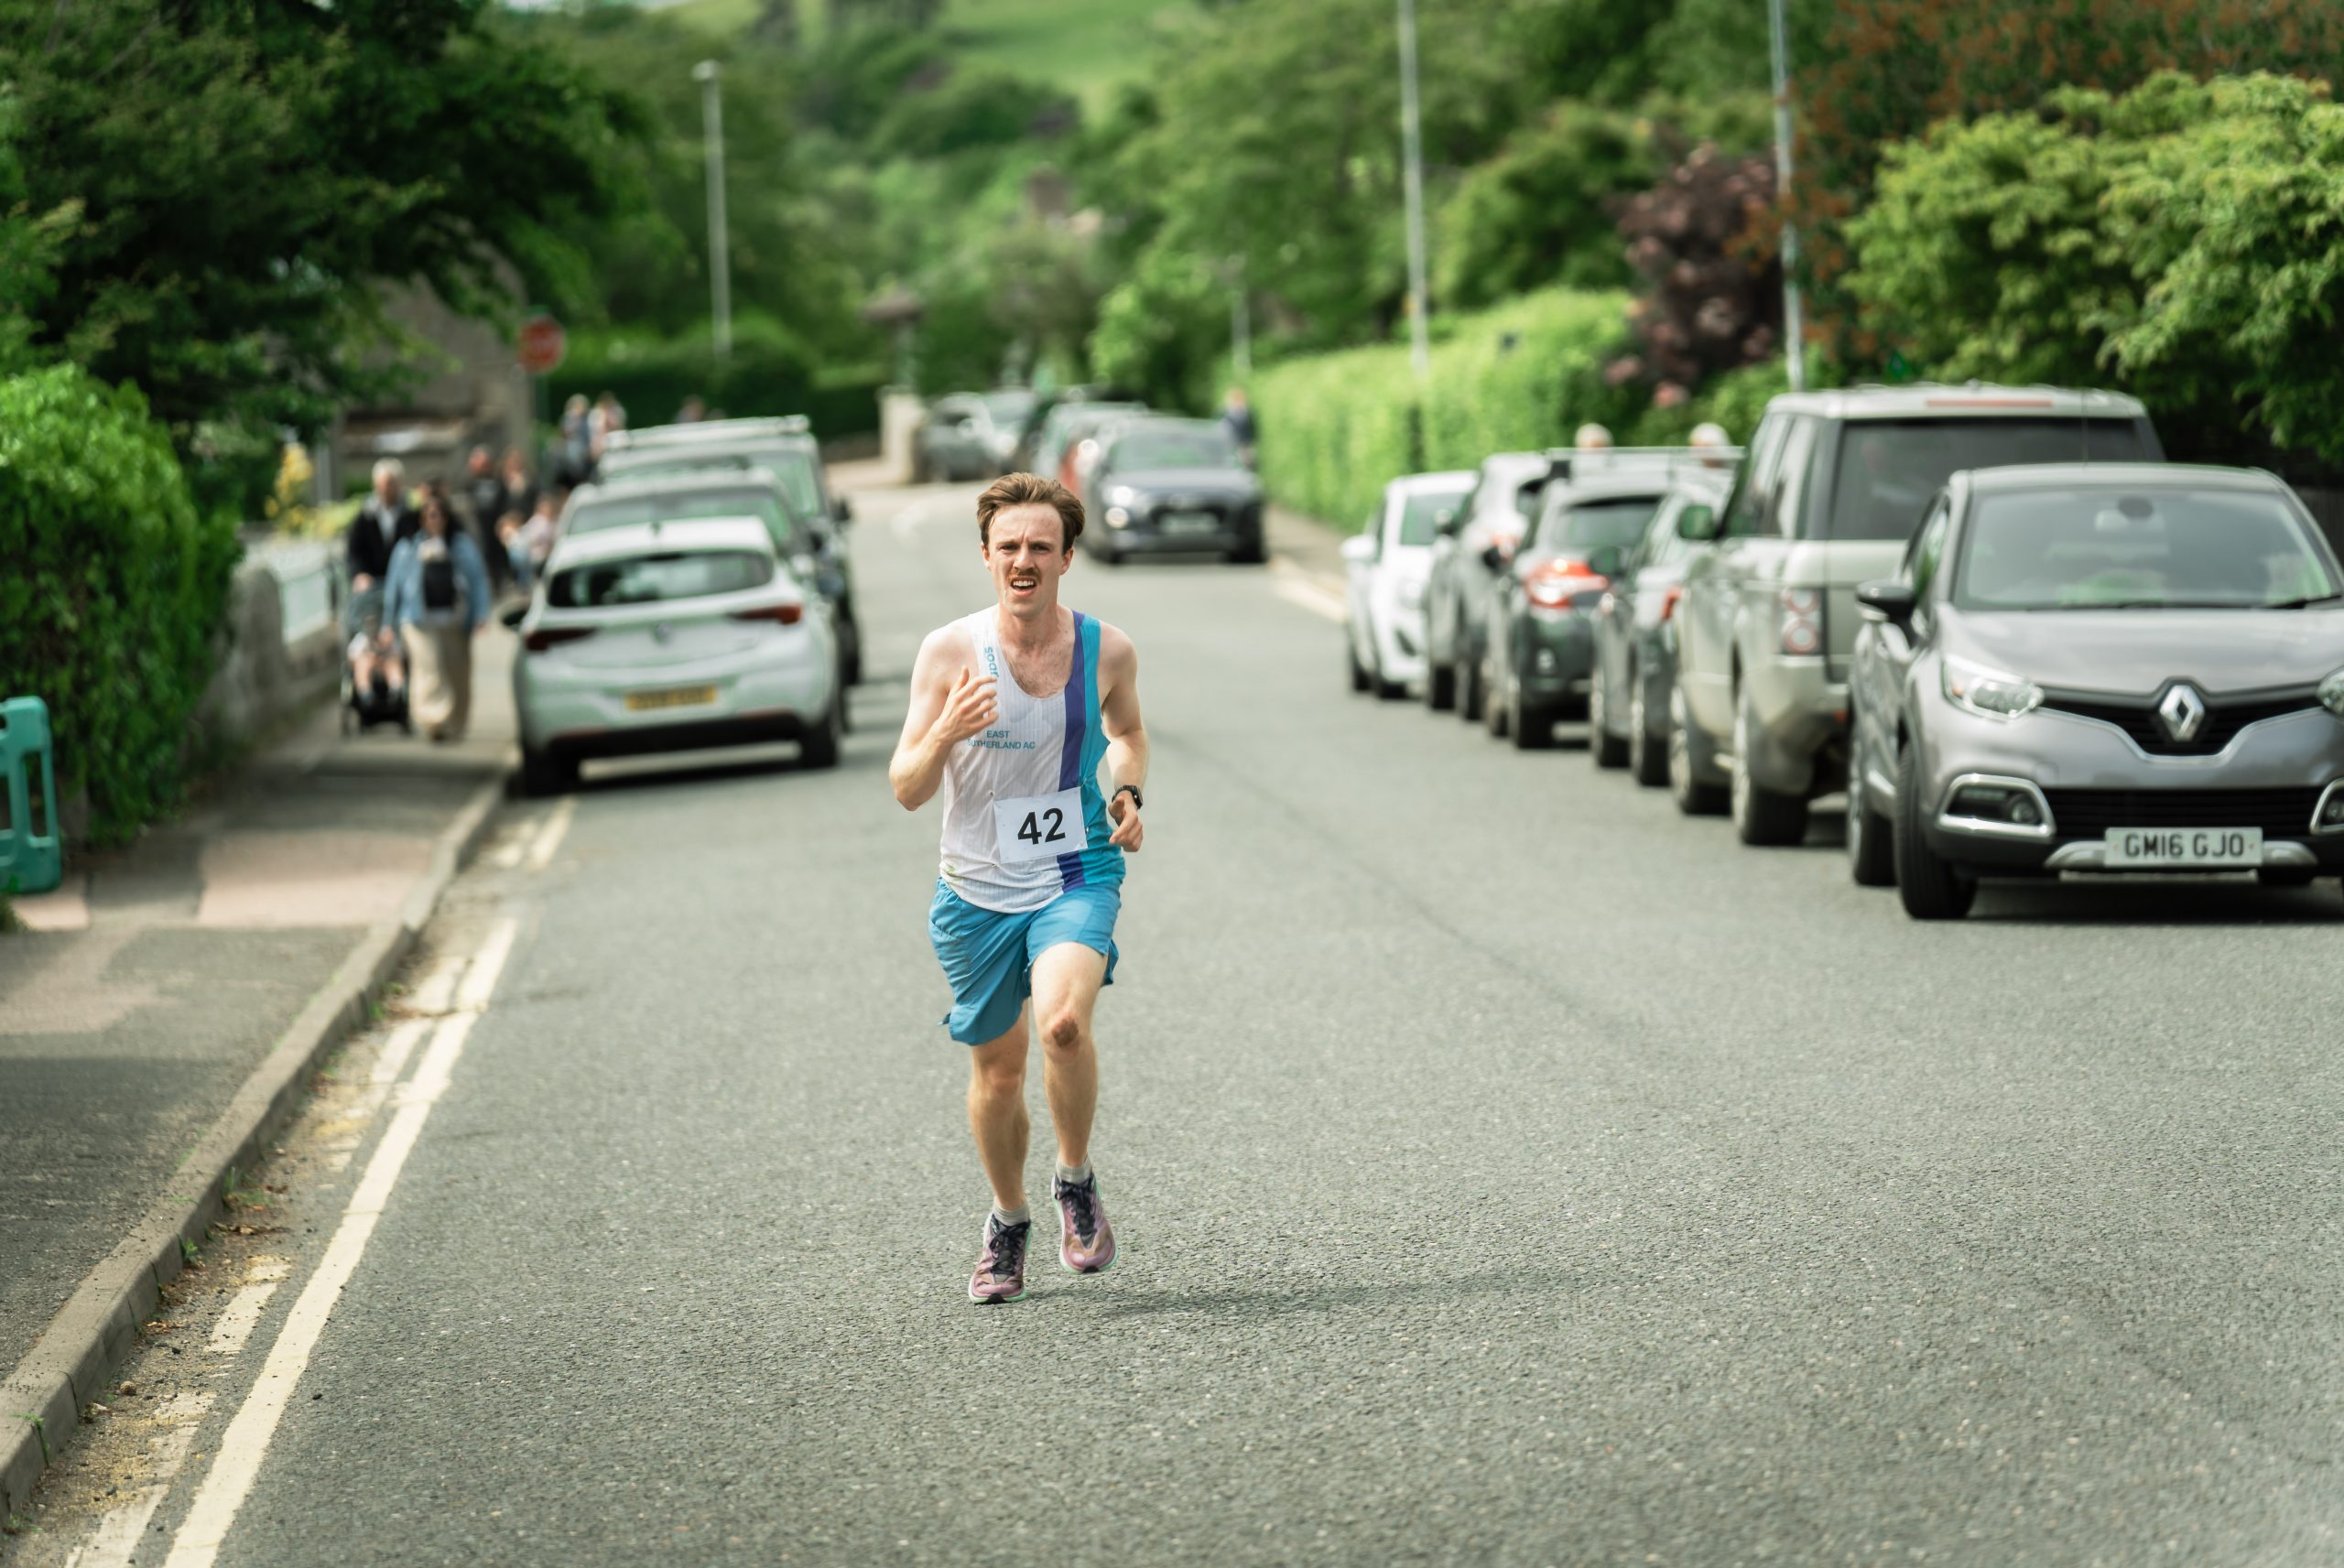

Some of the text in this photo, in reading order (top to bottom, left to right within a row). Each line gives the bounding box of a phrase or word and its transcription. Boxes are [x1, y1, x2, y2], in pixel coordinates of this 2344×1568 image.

[984, 646, 999, 678] soar
[967, 738, 1036, 750] SUTHERLAND AC
[986, 730, 1010, 739] EAST
[1017, 807, 1066, 845] 42
[2124, 833, 2244, 858] GM16 GJO
